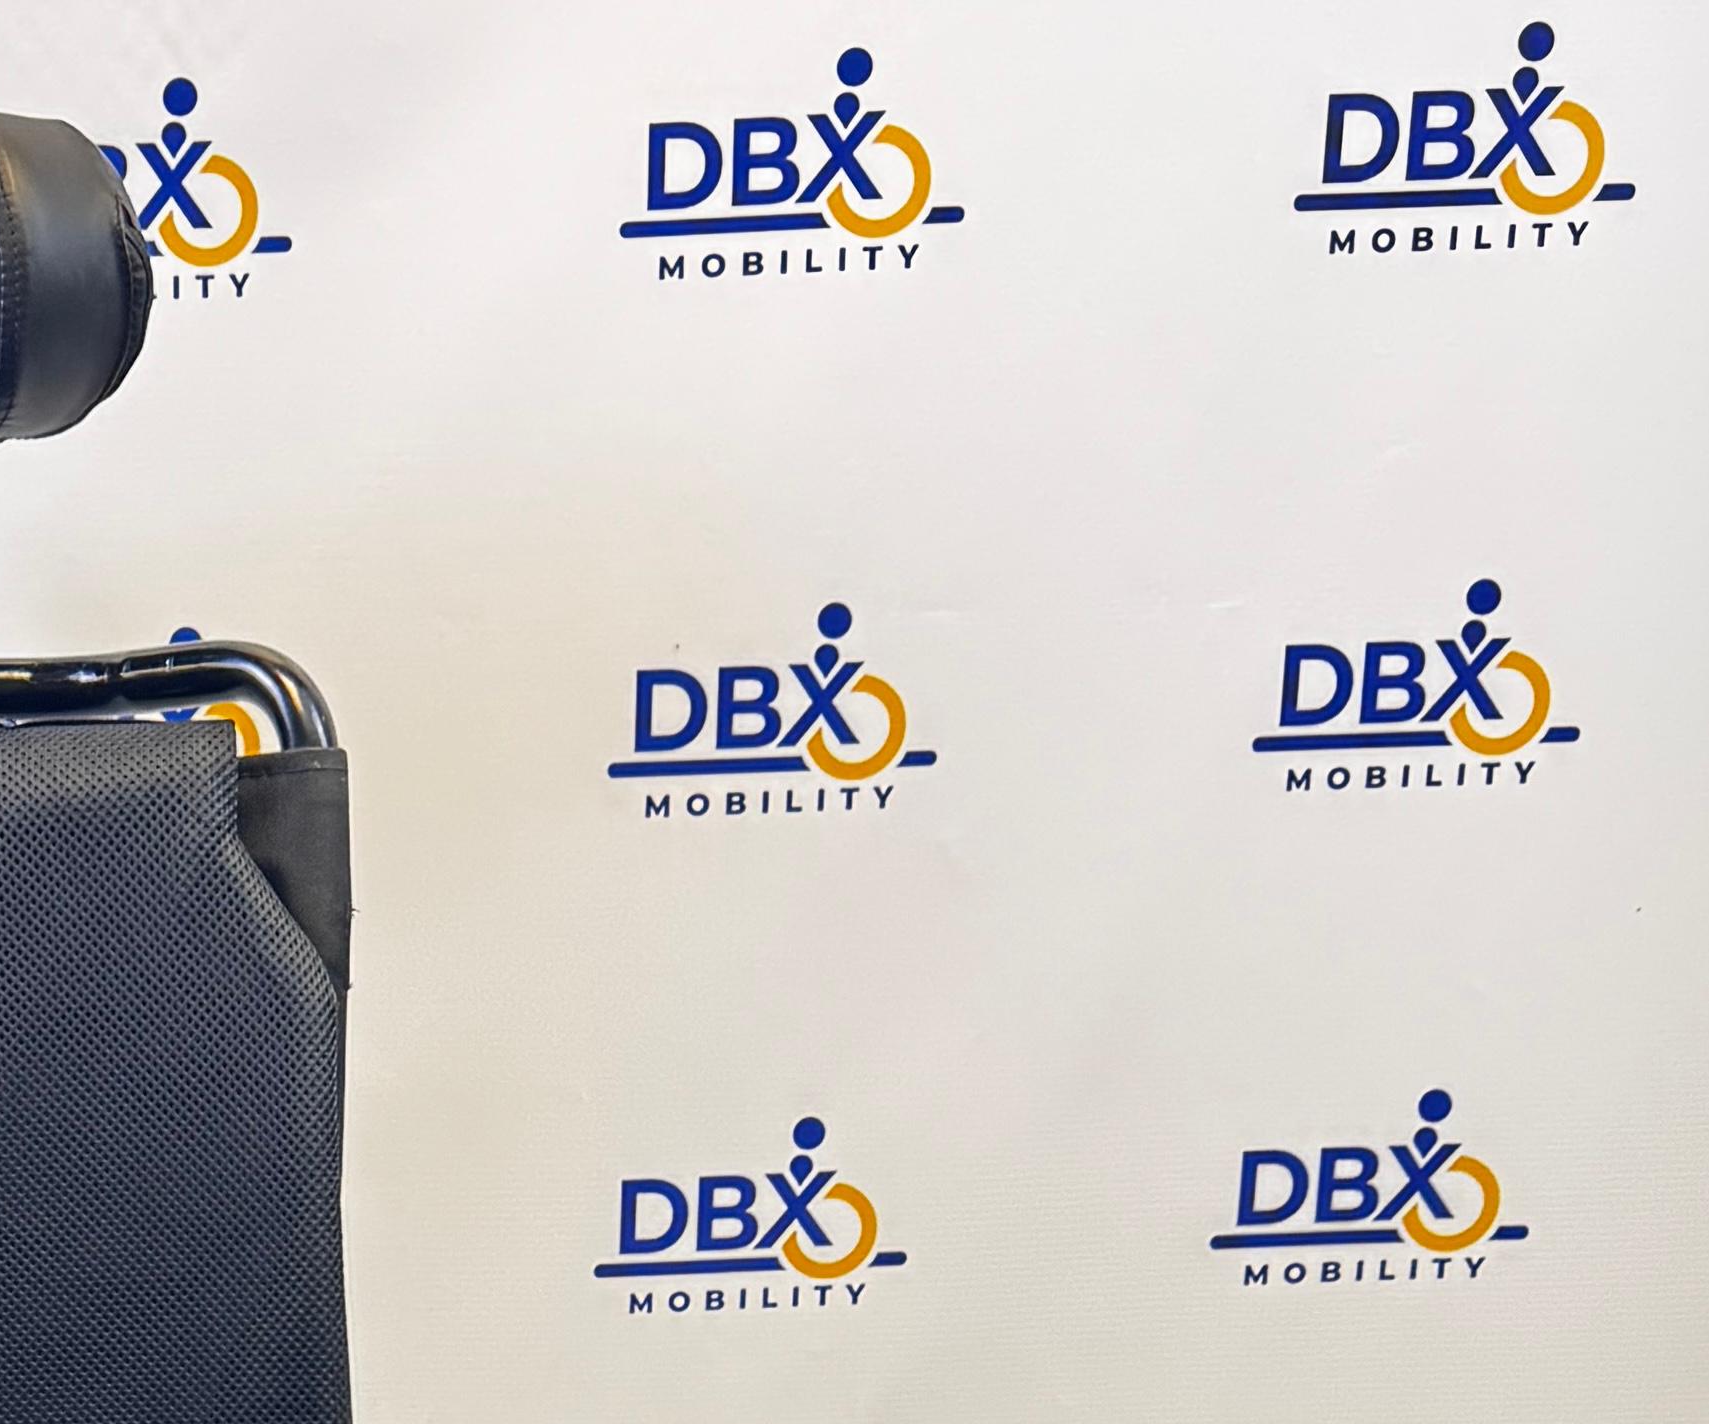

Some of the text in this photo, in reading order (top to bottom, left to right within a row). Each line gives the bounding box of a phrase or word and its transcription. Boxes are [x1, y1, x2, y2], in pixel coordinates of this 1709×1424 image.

[646, 110, 886, 212] DBX
[1321, 85, 1565, 184] DBX
[658, 243, 920, 281] MOBILITY
[1328, 220, 1589, 255] MOBILITY
[634, 661, 864, 753] DBX
[1278, 637, 1511, 728] DBX
[644, 785, 894, 819] MOBILITY
[1285, 760, 1536, 792] MOBILITY
[618, 1170, 837, 1255] DBX
[1236, 1143, 1462, 1227] DBX
[628, 1283, 866, 1315] MOBILITY
[1243, 1256, 1486, 1286] MOBILITY
